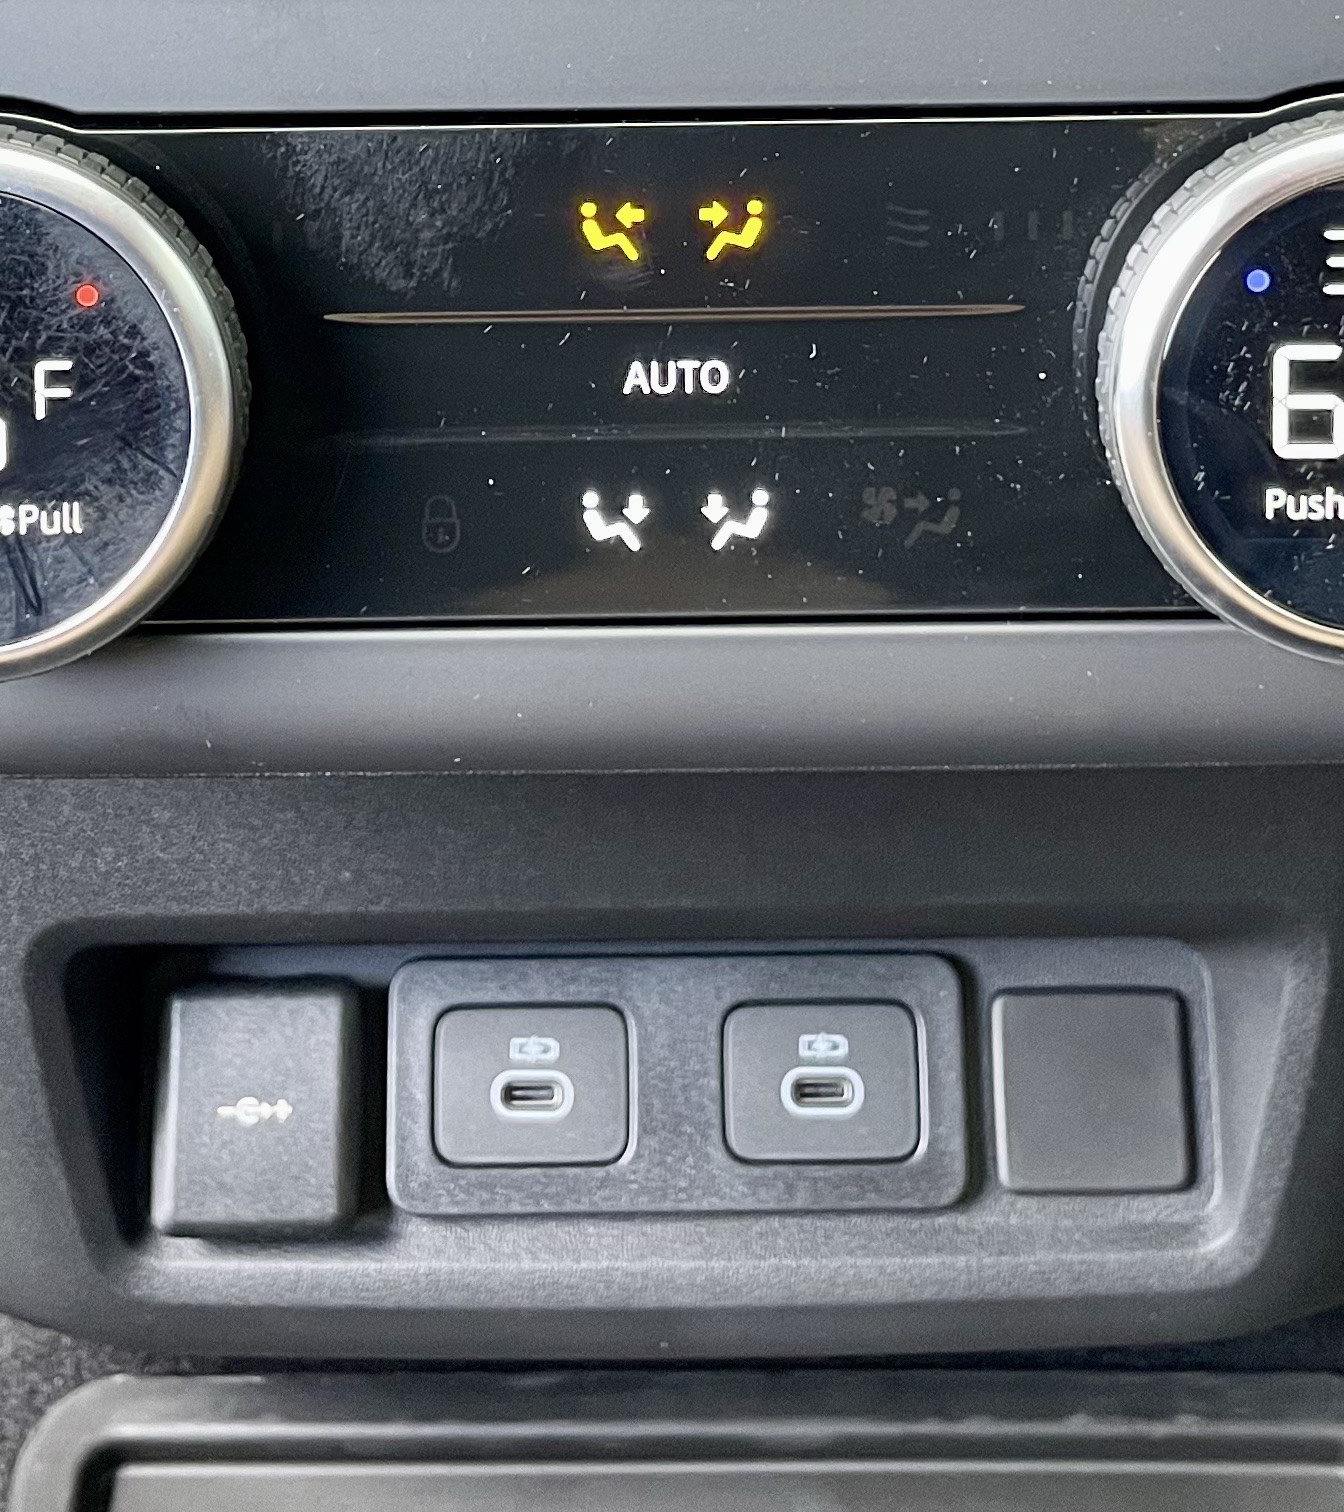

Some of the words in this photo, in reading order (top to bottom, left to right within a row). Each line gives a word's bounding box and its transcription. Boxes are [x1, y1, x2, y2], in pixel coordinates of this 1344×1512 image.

[34, 360, 73, 420] F
[623, 359, 730, 395] AUTO
[18, 502, 83, 535] Pull
